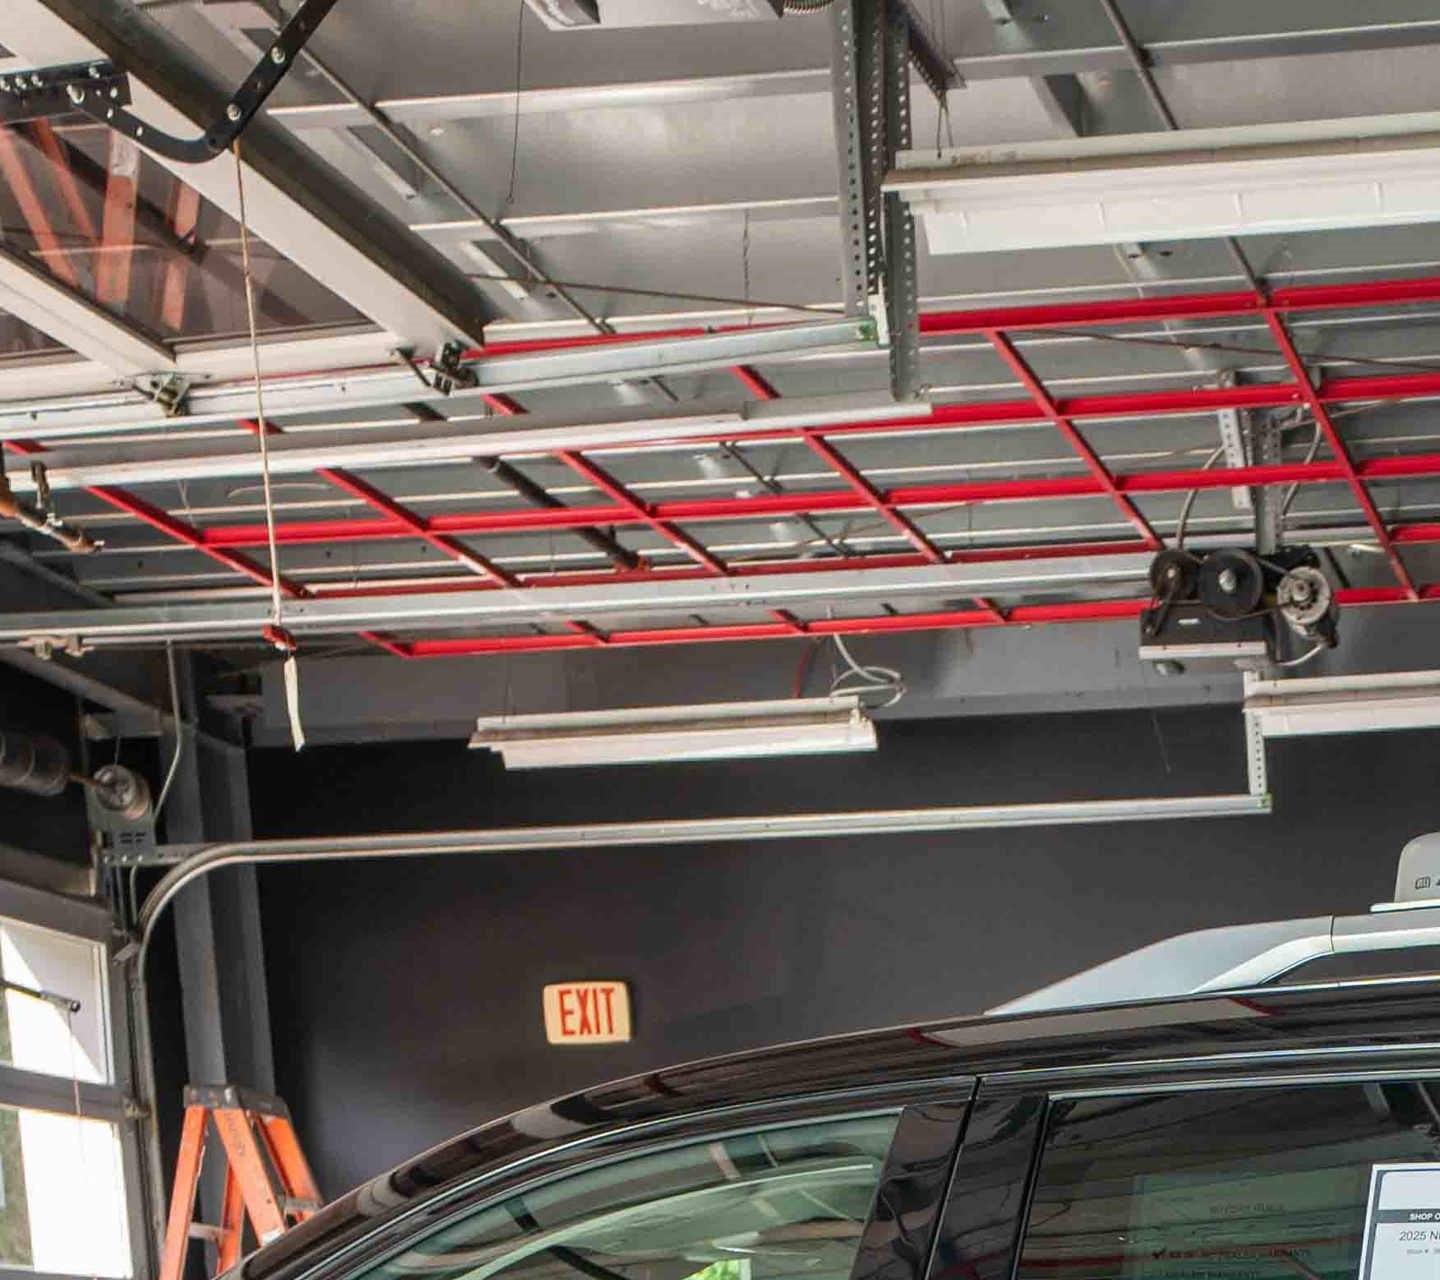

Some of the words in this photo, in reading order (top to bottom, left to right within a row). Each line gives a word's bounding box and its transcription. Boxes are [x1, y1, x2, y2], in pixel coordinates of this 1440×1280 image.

[558, 987, 614, 1036] EXIT
[1410, 1213, 1432, 1221] SHOP
[1399, 1231, 1427, 1241] 2025
